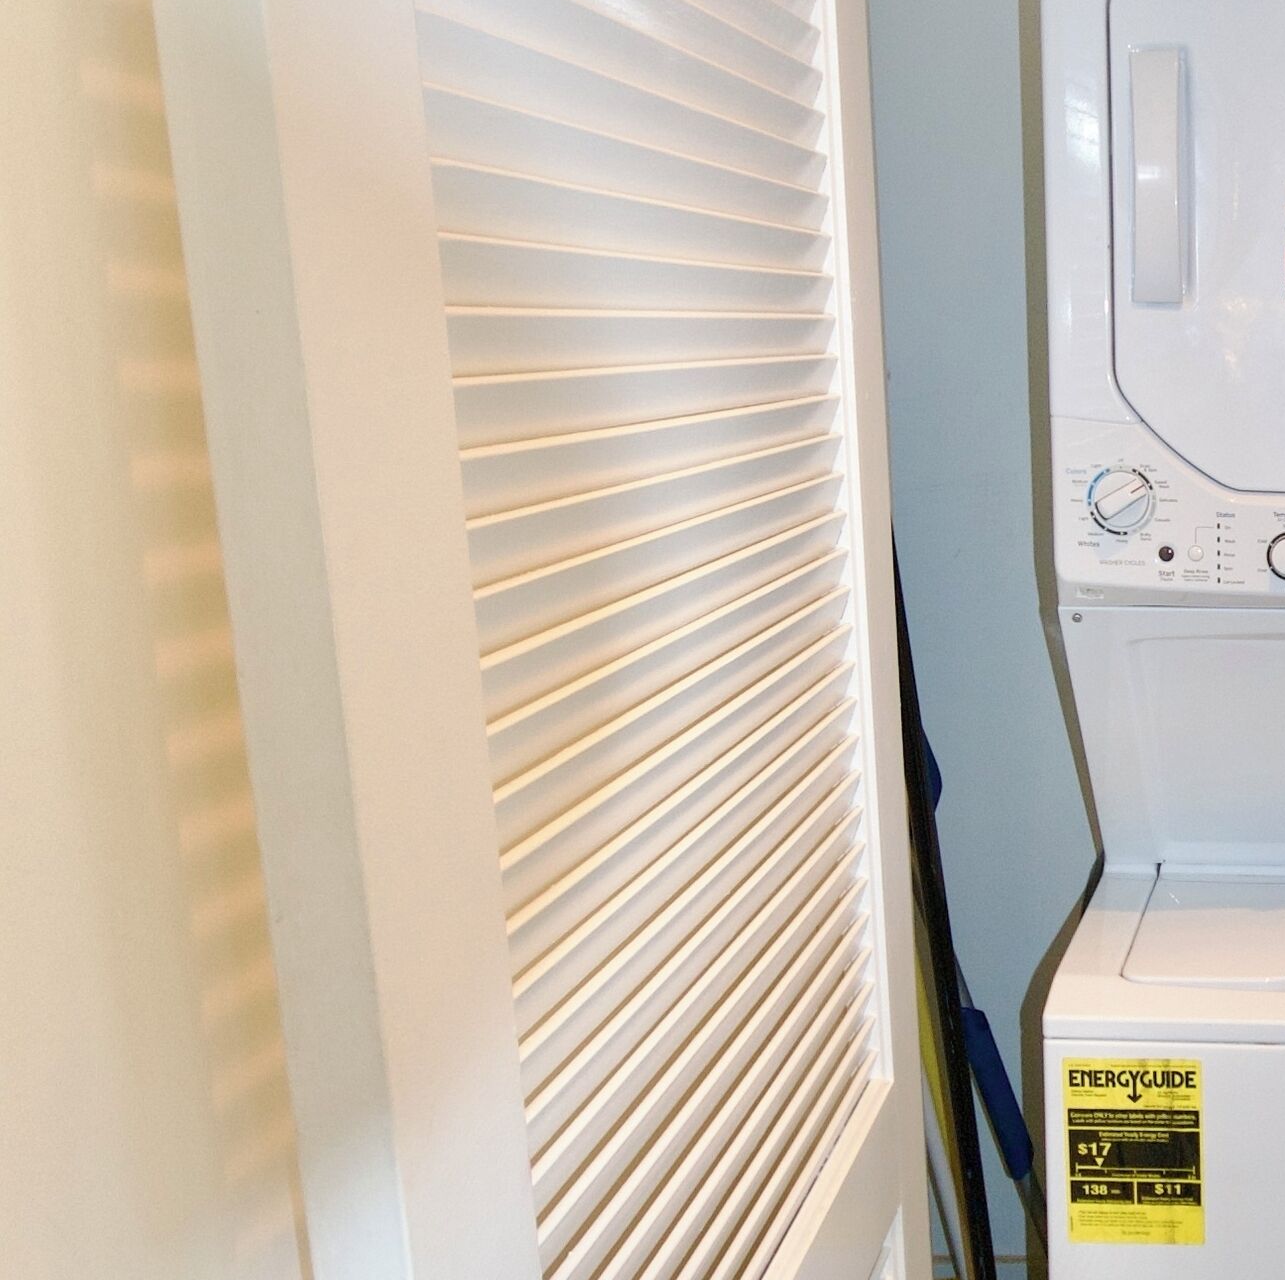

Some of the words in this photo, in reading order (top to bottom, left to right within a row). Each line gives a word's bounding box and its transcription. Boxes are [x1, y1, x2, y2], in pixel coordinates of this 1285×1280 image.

[1069, 1069, 1197, 1091] ENERGYGUIDE
[1078, 1142, 1112, 1156] $17
[1082, 1184, 1108, 1196] 138
[1154, 1183, 1183, 1196] $11
